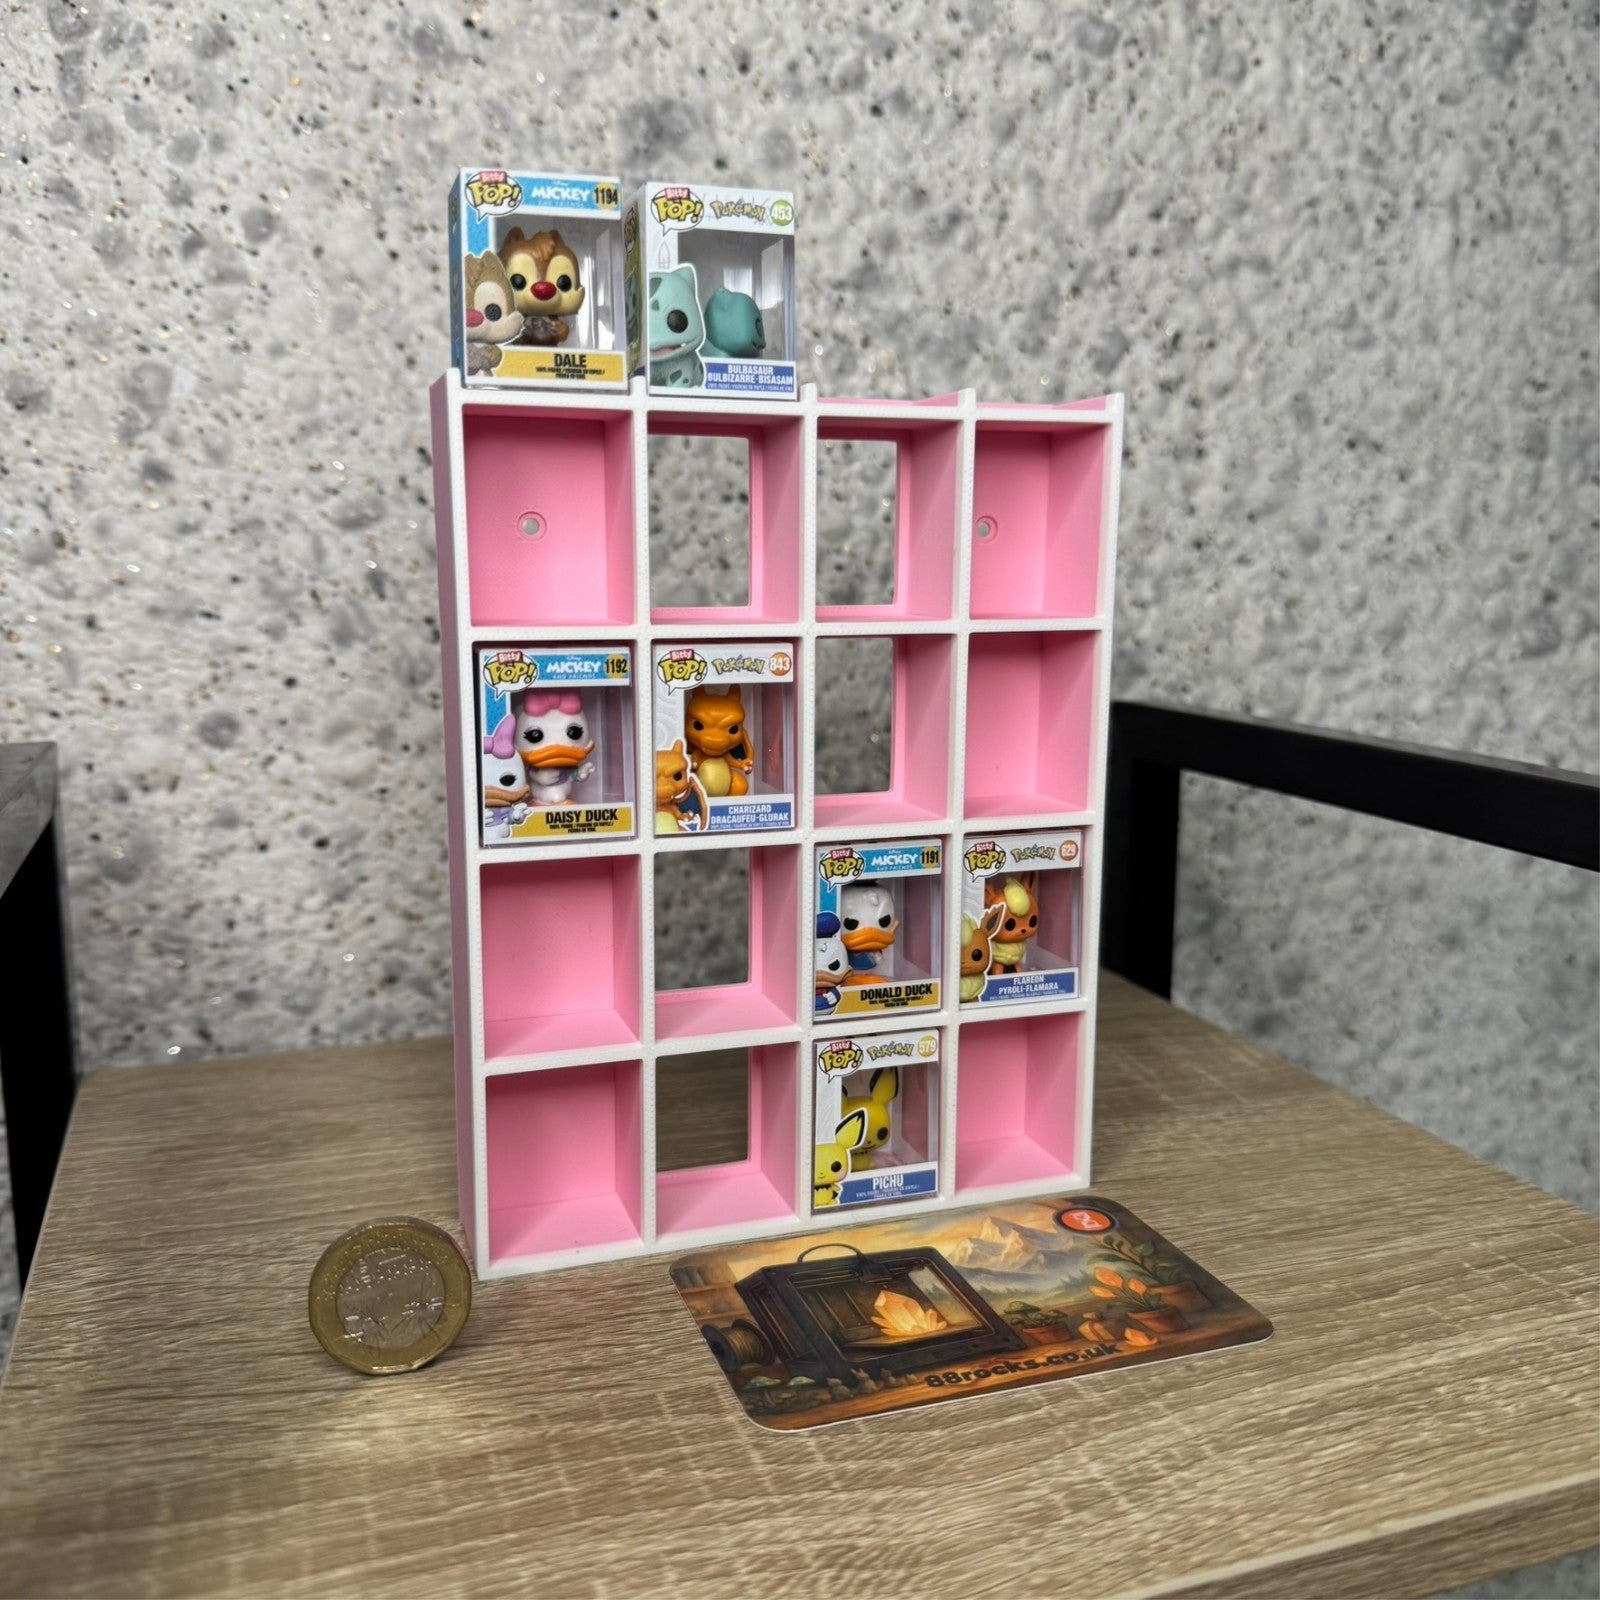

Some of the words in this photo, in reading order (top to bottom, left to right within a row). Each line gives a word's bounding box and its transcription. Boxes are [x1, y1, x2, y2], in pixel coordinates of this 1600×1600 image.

[531, 186, 591, 202] MICKEY
[594, 187, 618, 205] 1194
[666, 187, 689, 199] Bitty
[653, 196, 703, 223] POP!
[771, 206, 792, 221] 453
[554, 353, 587, 368] DALE
[727, 364, 773, 375] BULBASAUR
[498, 651, 521, 663] Bitty
[671, 649, 693, 661] Bitty
[546, 661, 601, 673] MICKEY
[604, 659, 628, 674] 1192
[658, 658, 707, 683] POP!
[769, 657, 791, 671] 843
[485, 661, 537, 686] POP!
[545, 810, 582, 825] DAISY
[585, 808, 618, 822] DUCK
[728, 804, 772, 815] CHARIZARD
[871, 854, 918, 866] MICKEY
[920, 850, 939, 865] 1191
[964, 850, 1006, 872] POP!
[820, 856, 864, 880] POP!
[1013, 975, 1045, 985] FLAREON
[860, 986, 902, 1001] DONALD
[904, 983, 932, 997] DUCK
[998, 982, 1059, 995] PYROLI-FLAMARA
[919, 1039, 936, 1053] 579
[819, 1049, 863, 1072] POP!
[872, 1174, 904, 1190] PICHU
[923, 1343, 1122, 1388] 88rocks.co.uk
